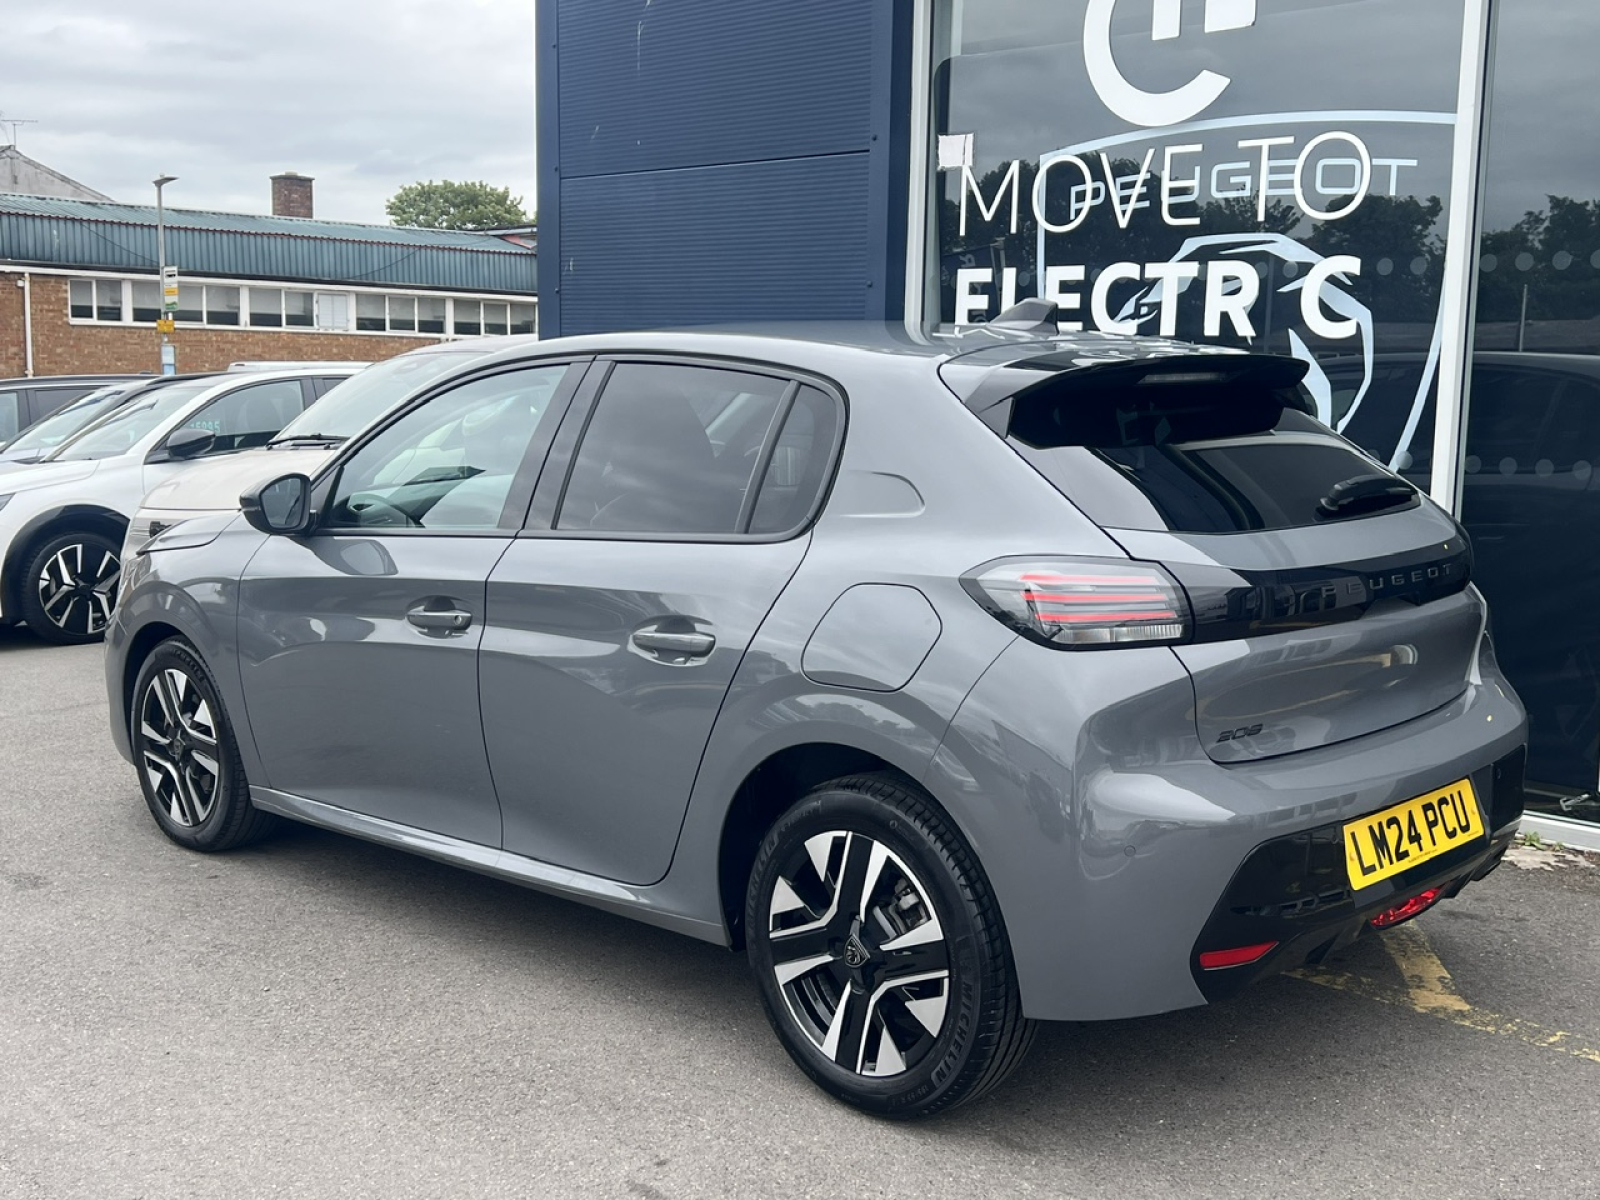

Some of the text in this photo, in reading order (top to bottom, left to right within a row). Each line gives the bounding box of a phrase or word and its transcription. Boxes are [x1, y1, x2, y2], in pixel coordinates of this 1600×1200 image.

[958, 130, 1373, 237] MOVE TO
[1070, 158, 1418, 221] PEUGEOT
[1321, 563, 1453, 598] PEUGEOT
[1216, 723, 1263, 743] 208
[1350, 790, 1471, 876] LM24 PCU
[934, 981, 974, 1085] MICHELIN
